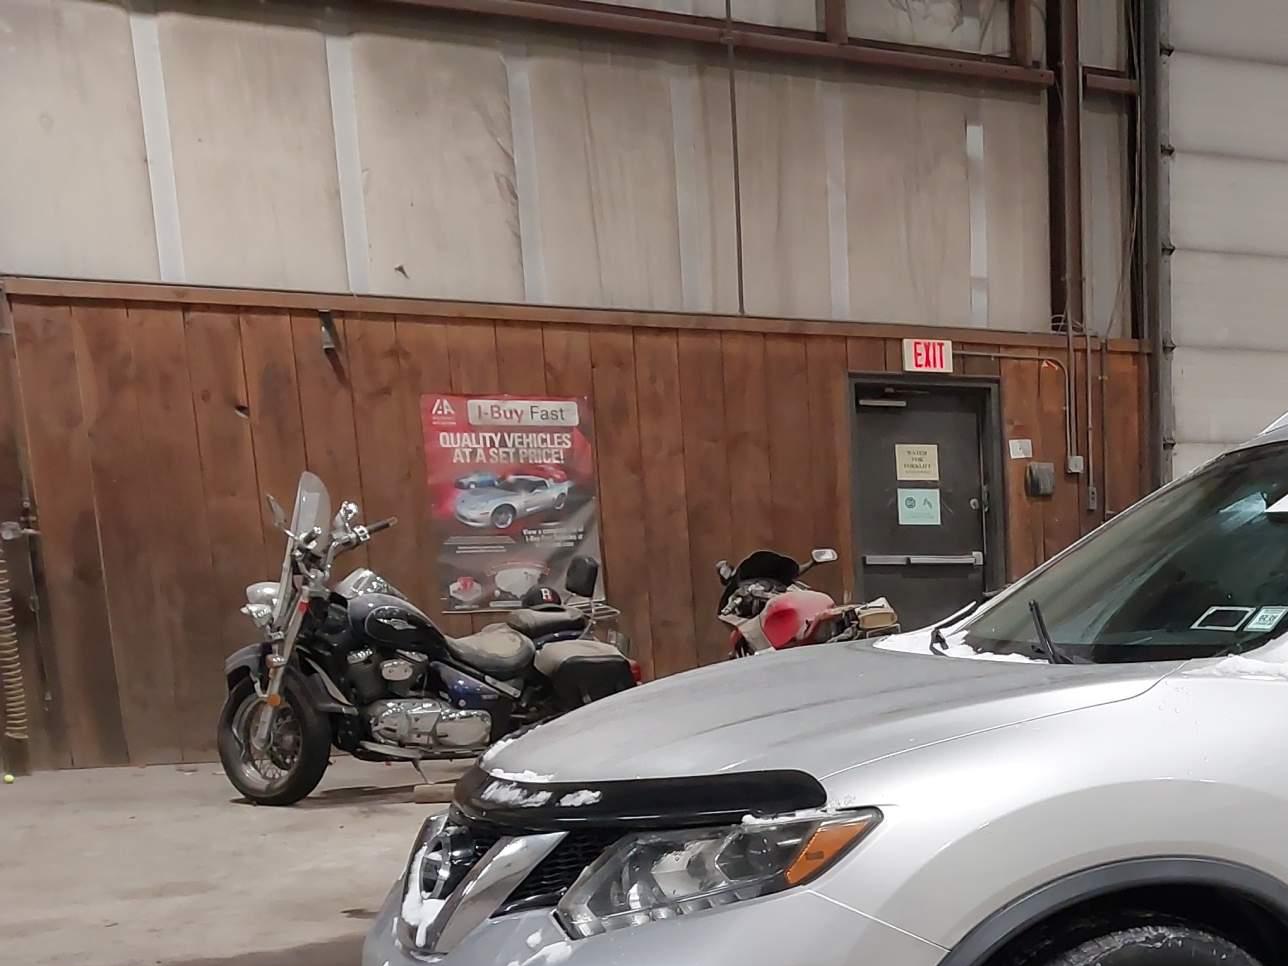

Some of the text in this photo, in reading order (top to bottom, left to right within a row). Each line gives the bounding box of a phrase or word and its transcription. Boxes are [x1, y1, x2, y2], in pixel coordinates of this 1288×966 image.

[913, 341, 945, 369] EXIT
[478, 404, 565, 423] I-Buy Fast
[439, 432, 572, 449] QUALITY VEHICLES
[453, 448, 565, 464] AT A SET PRICE!
